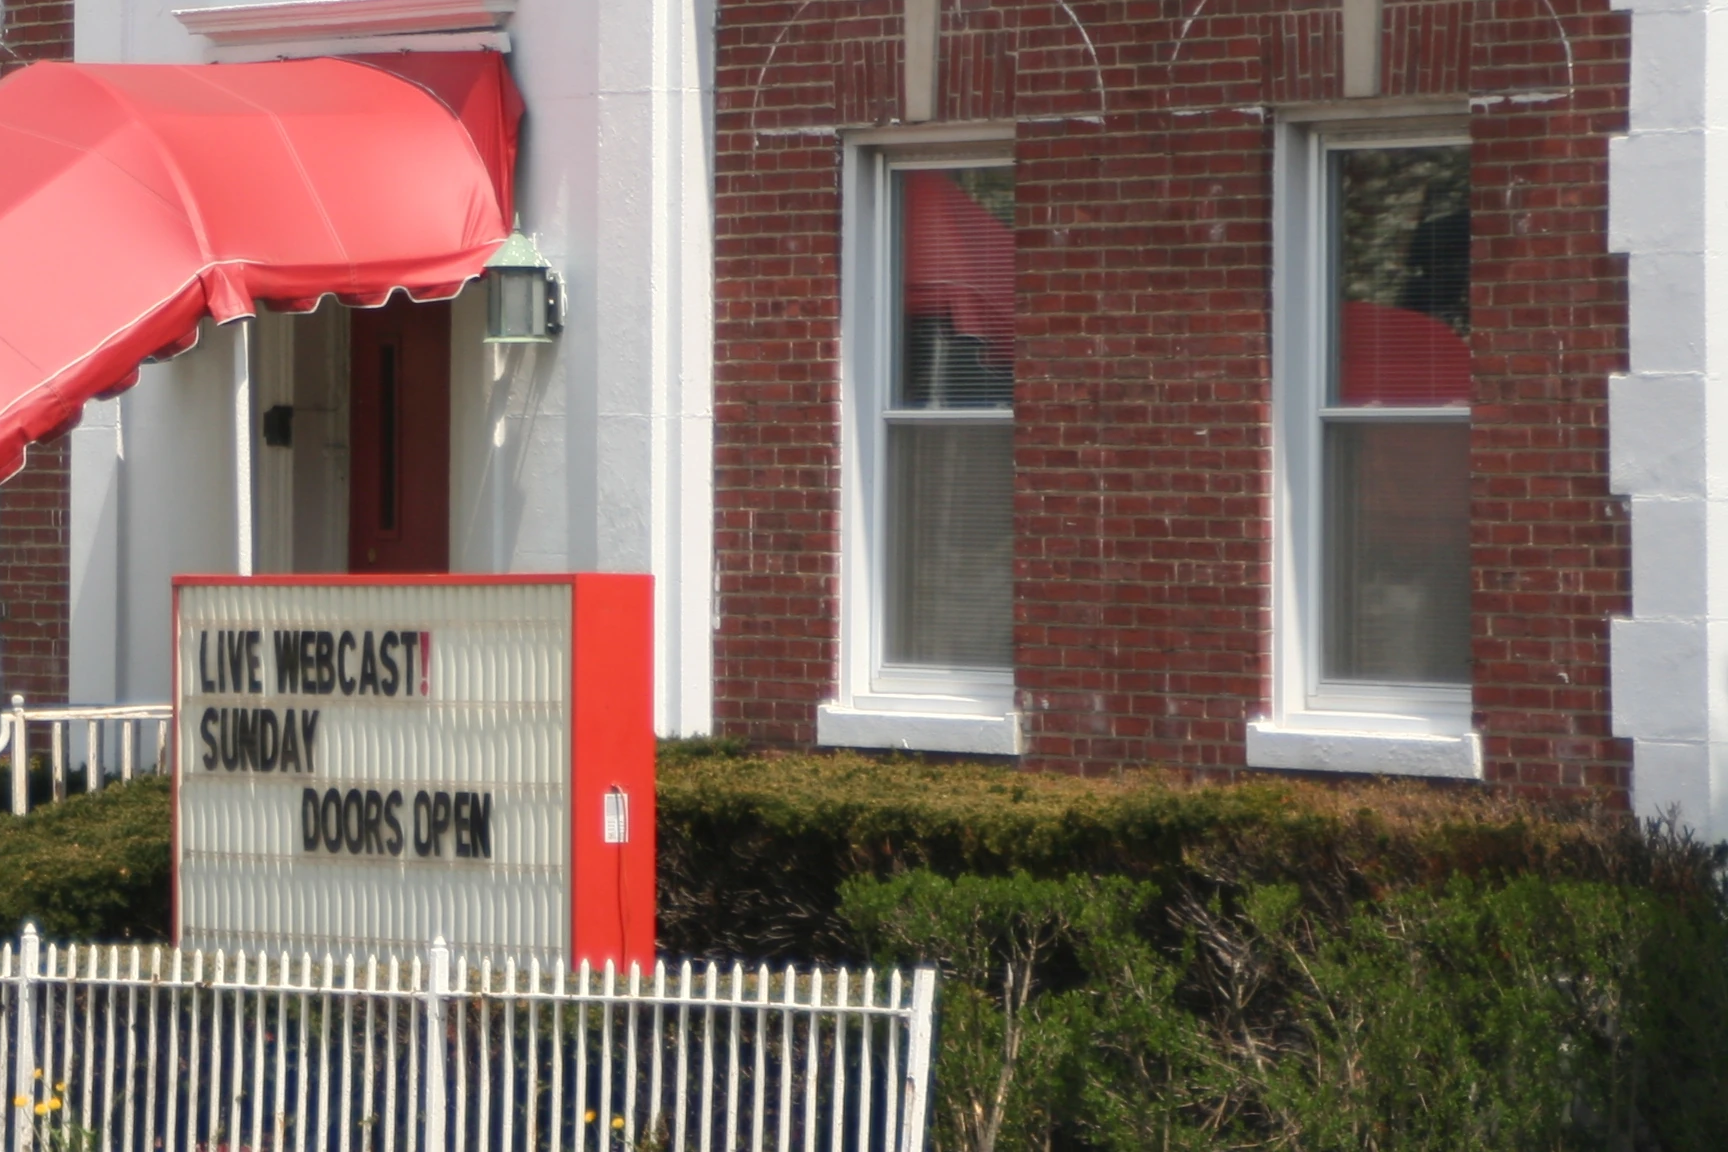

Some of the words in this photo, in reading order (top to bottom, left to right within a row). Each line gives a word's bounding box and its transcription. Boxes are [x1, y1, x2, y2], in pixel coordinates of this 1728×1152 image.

[200, 631, 263, 694] LIVE
[274, 630, 431, 697] WEBCAST!
[200, 707, 320, 774] SUNDAY
[301, 788, 404, 857] DOORS
[413, 790, 492, 859] OPEN
